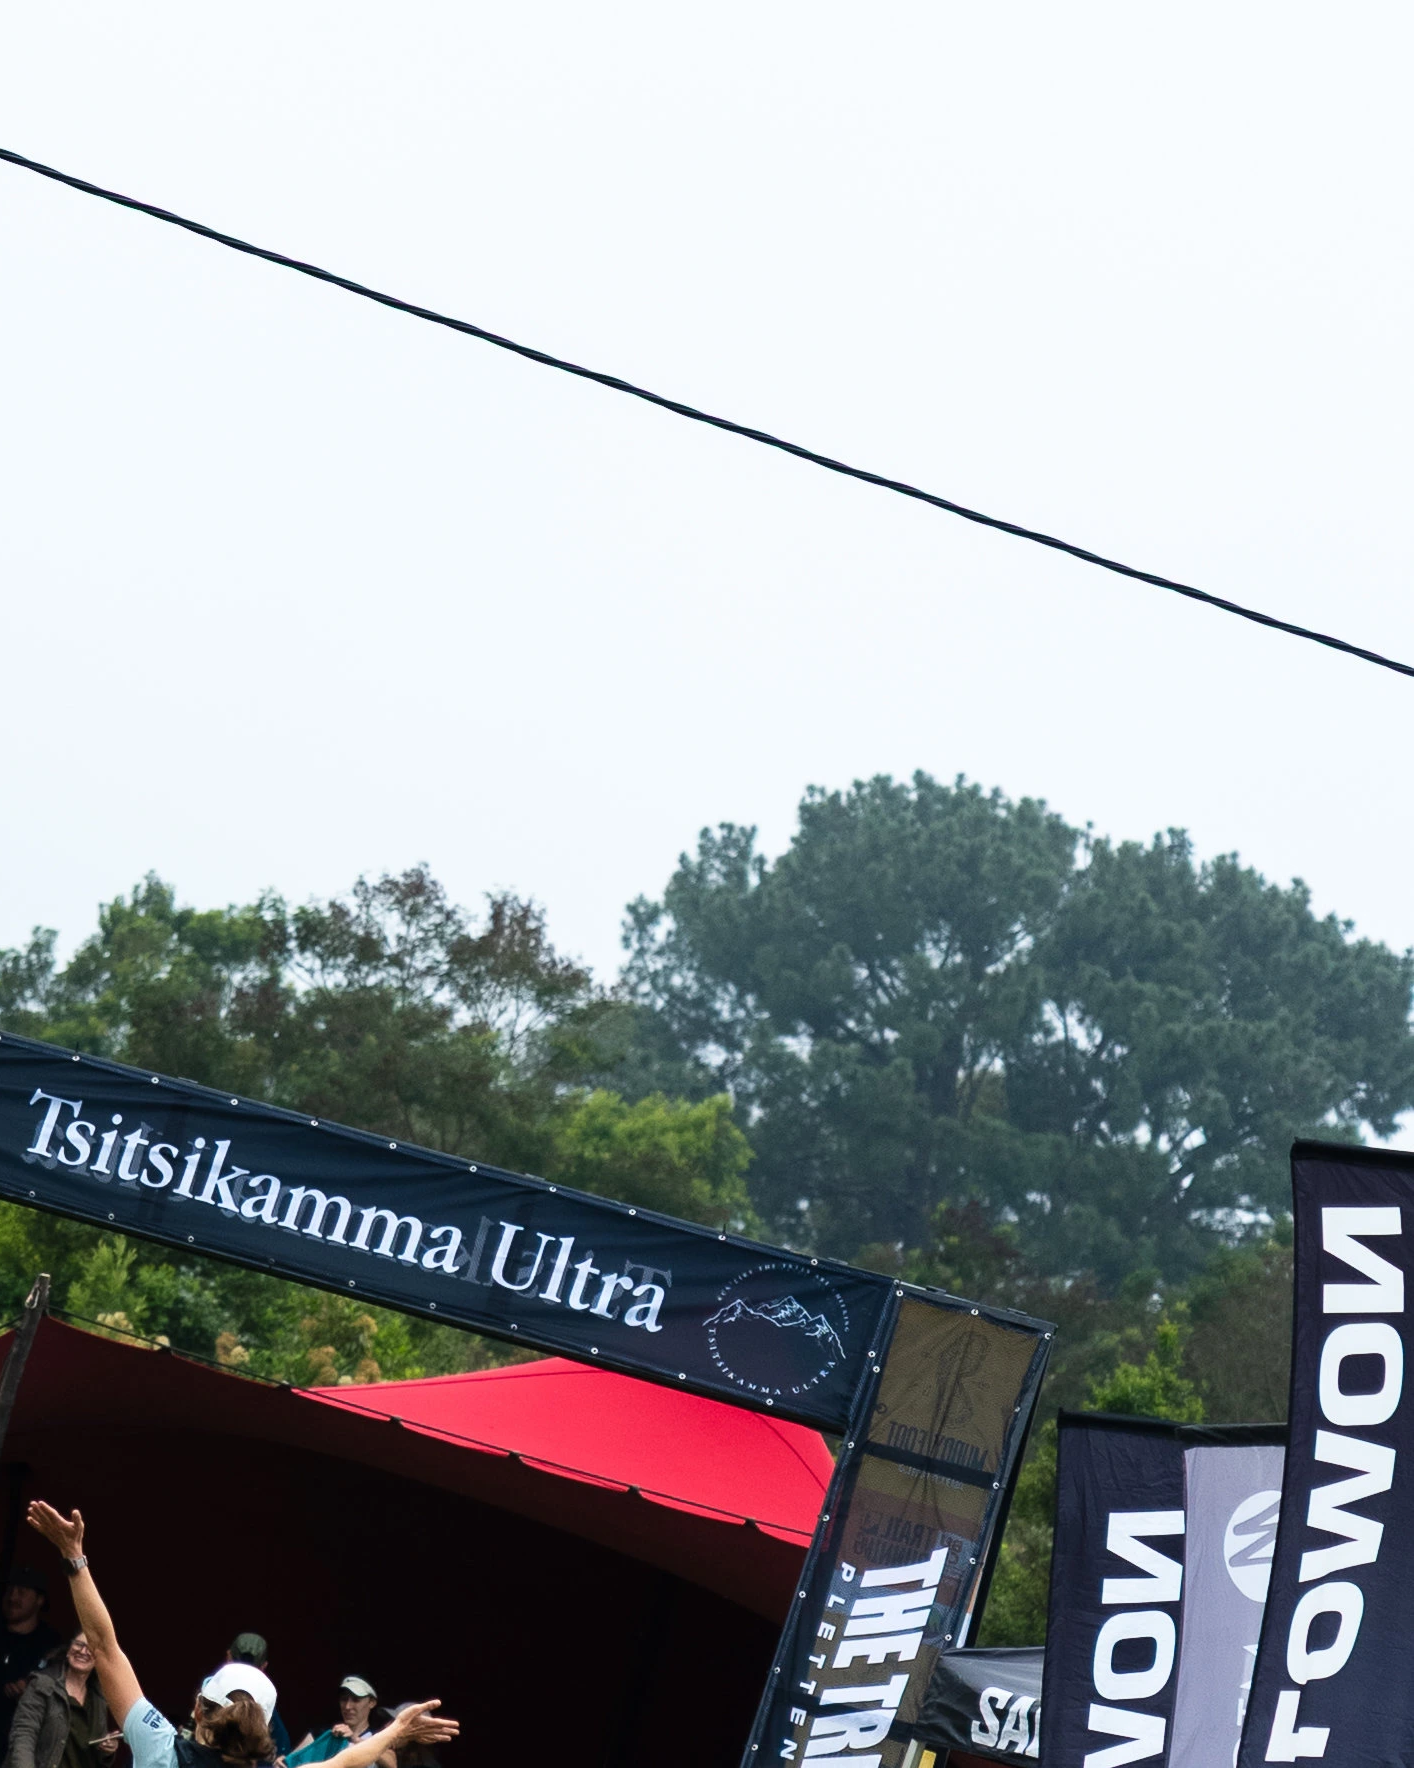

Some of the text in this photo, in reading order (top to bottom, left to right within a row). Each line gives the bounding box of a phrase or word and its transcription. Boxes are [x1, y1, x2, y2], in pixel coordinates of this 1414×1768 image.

[26, 1087, 665, 1333] Tsitsikamma Ultra
[708, 1328, 836, 1395] TSITSIKAMMA ULTRA
[831, 1547, 950, 1670] THE
